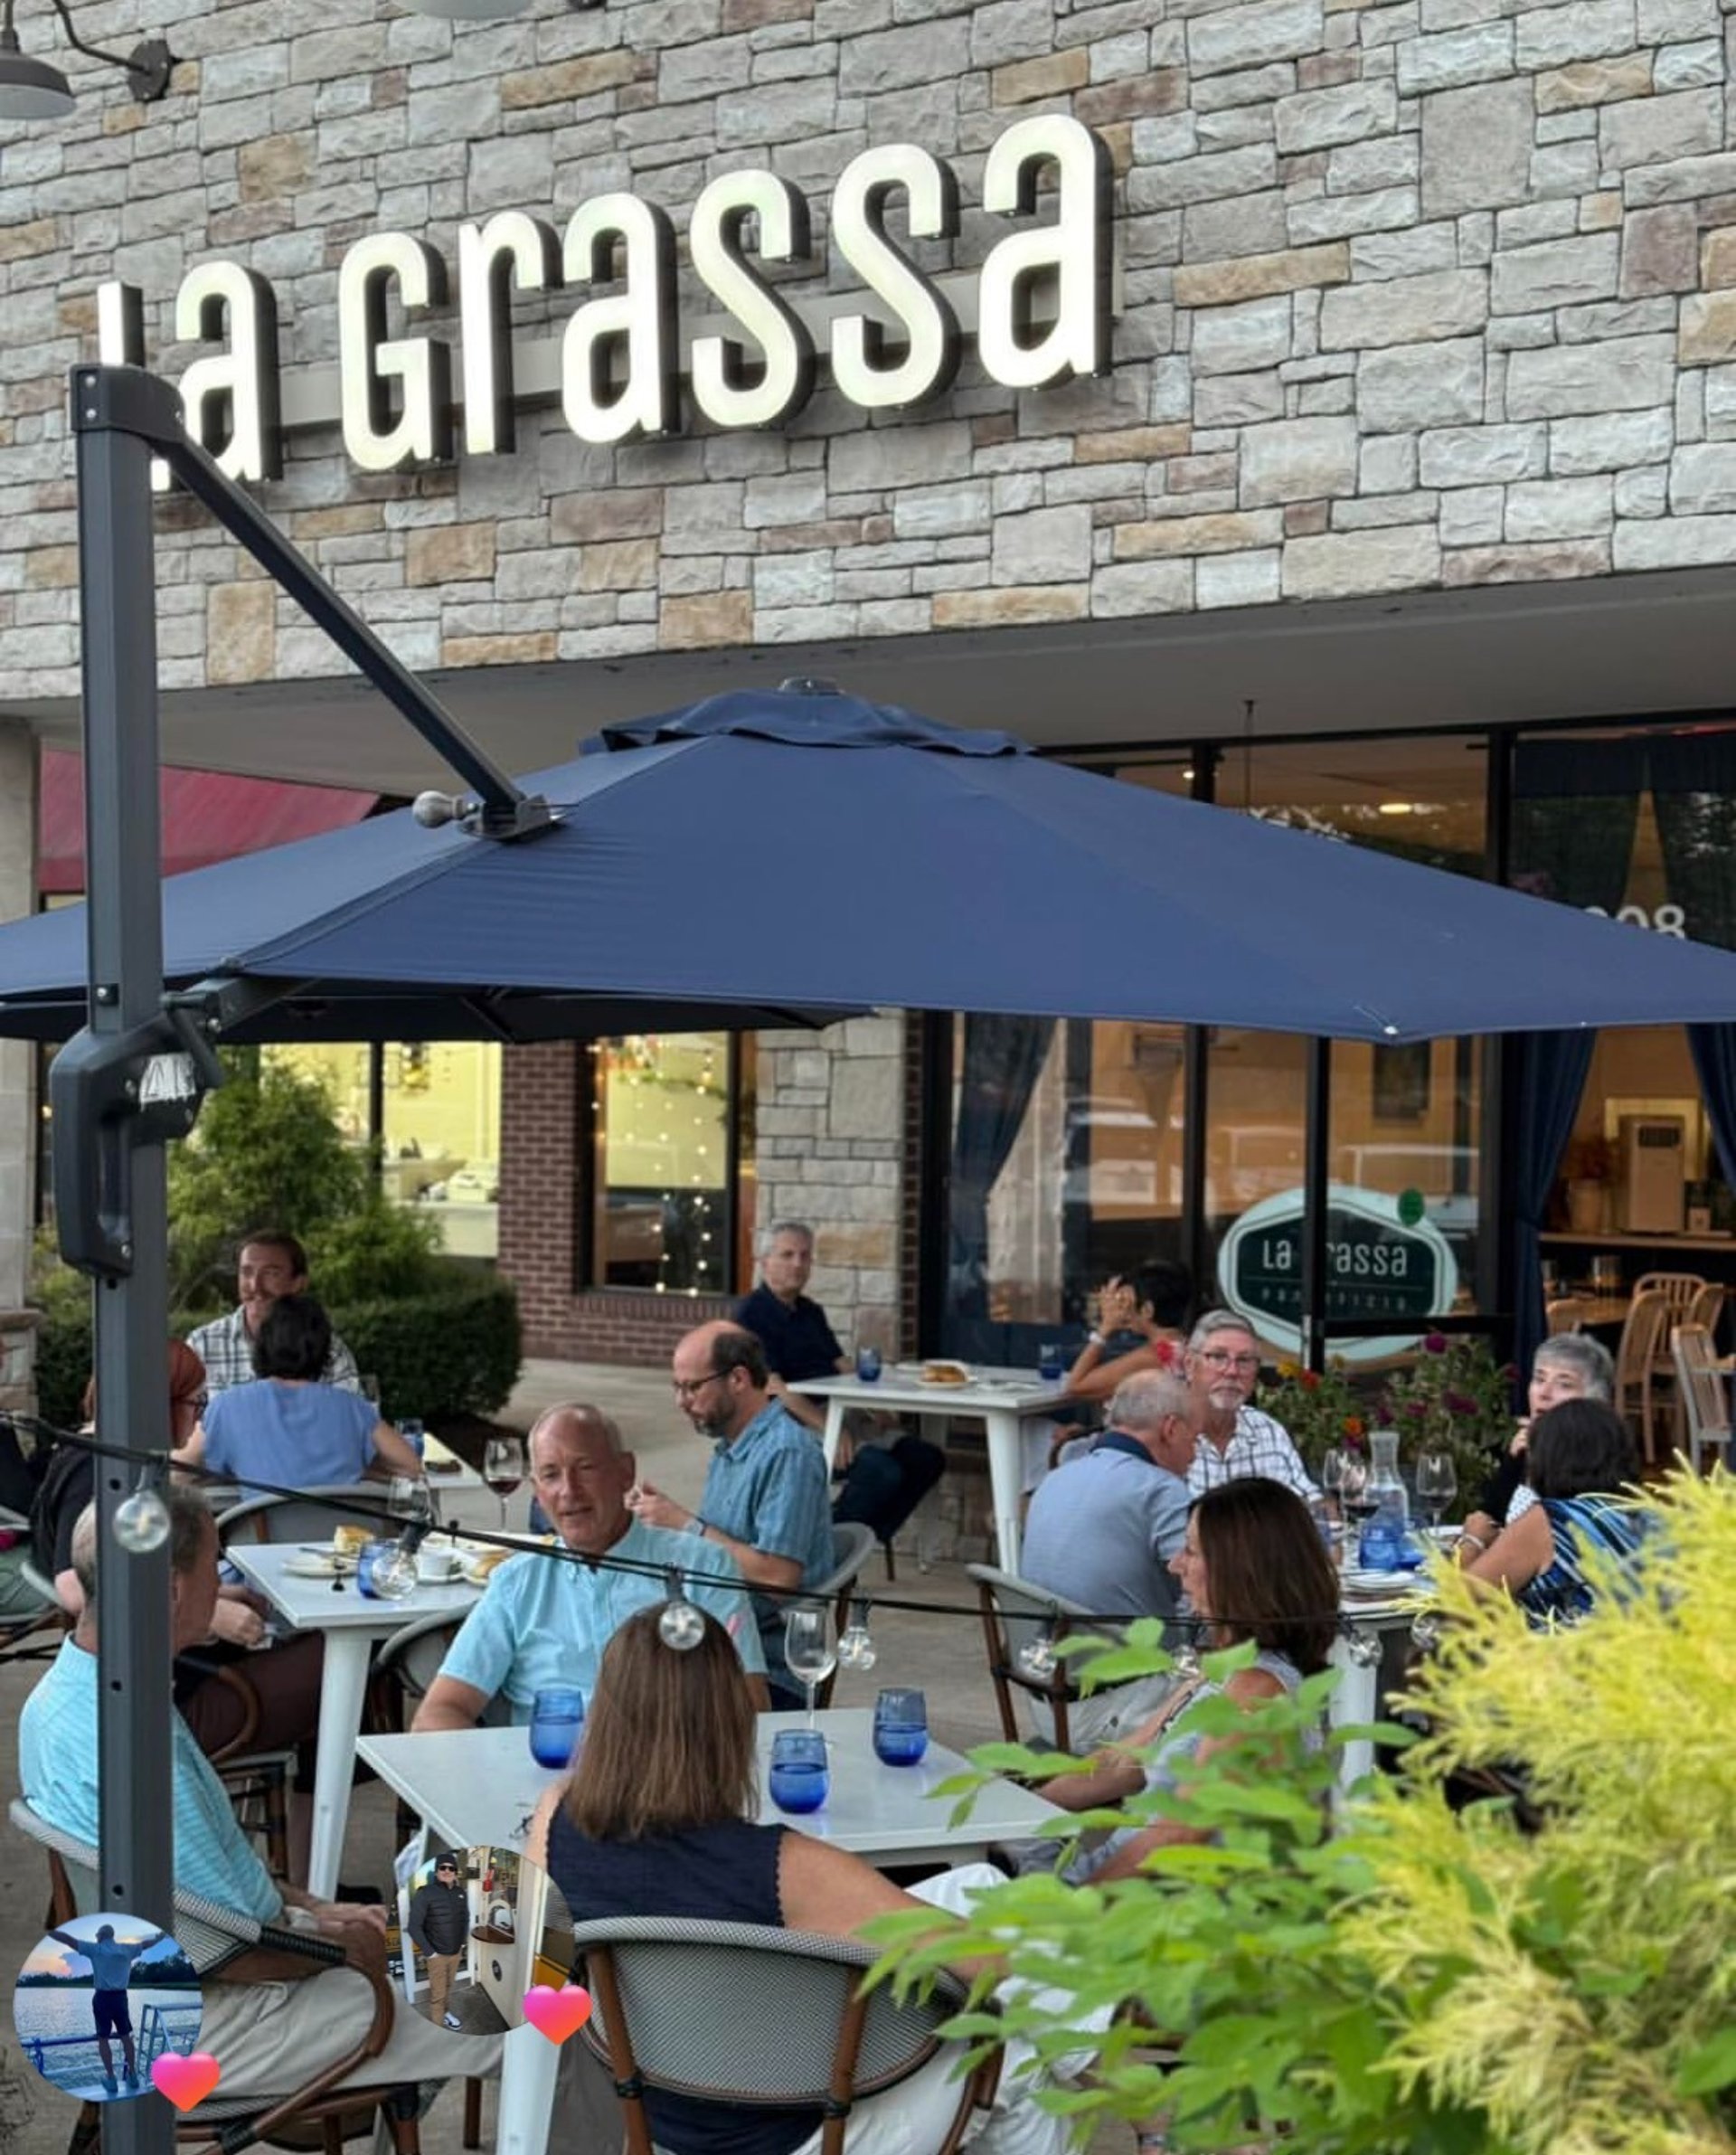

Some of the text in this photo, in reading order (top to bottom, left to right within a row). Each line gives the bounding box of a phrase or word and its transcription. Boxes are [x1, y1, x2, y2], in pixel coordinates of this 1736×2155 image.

[337, 113, 1099, 471] Grassa
[1261, 1238, 1409, 1278] La assa
